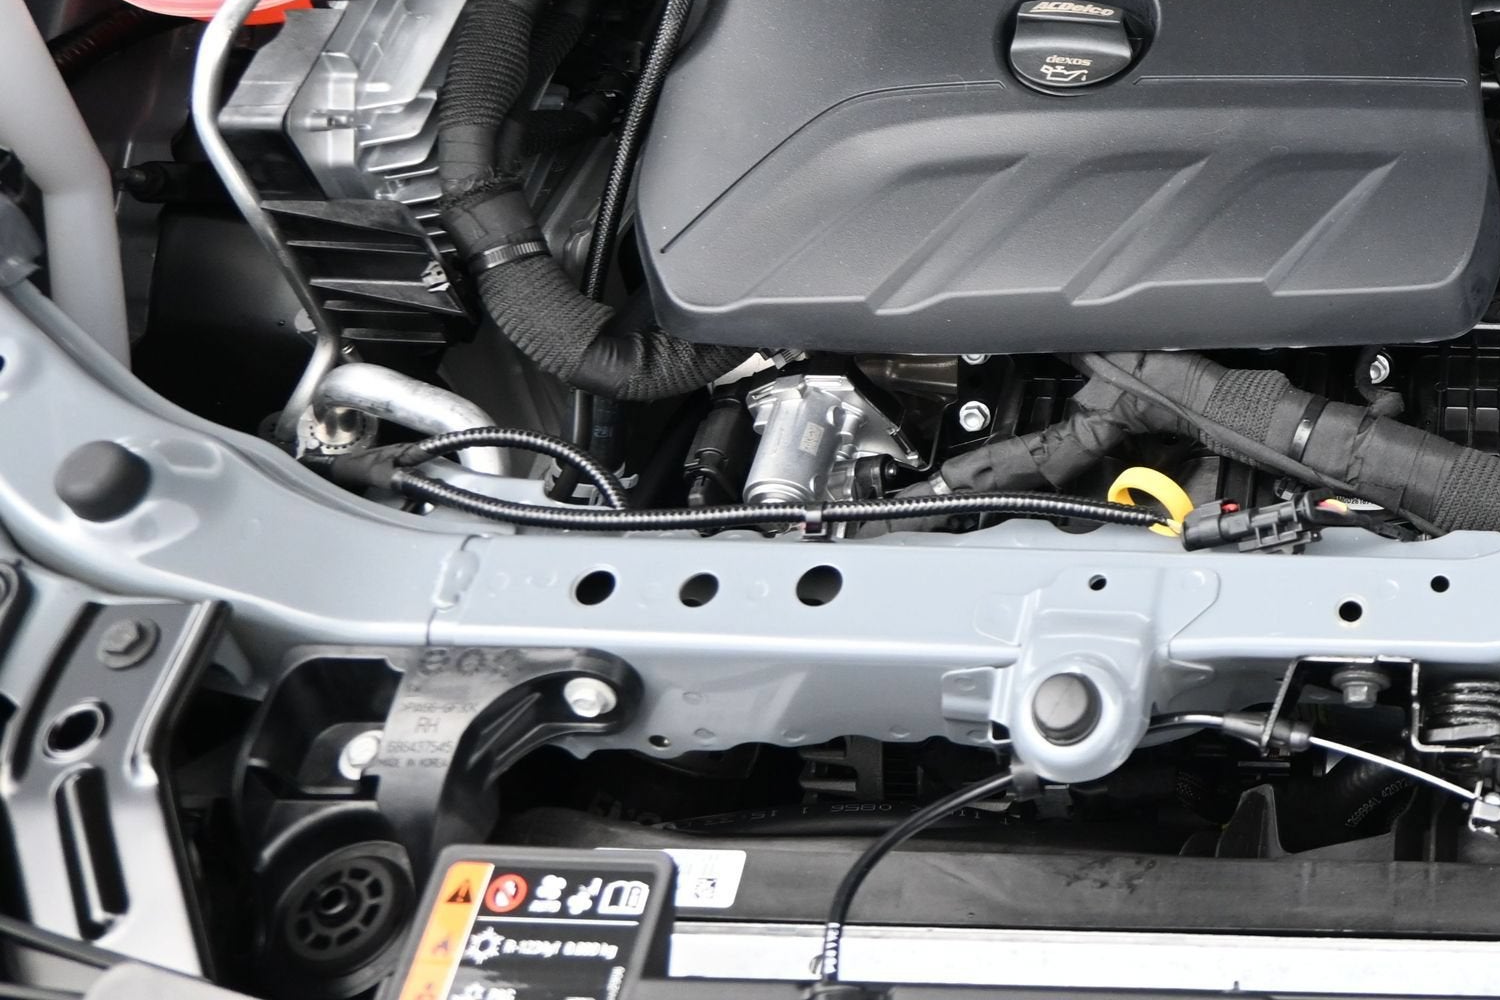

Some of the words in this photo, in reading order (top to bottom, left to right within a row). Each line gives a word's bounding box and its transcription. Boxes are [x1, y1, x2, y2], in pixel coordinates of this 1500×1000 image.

[1031, 1, 1115, 17] ACDelco
[1045, 55, 1094, 67] dexos
[415, 716, 441, 734] RH
